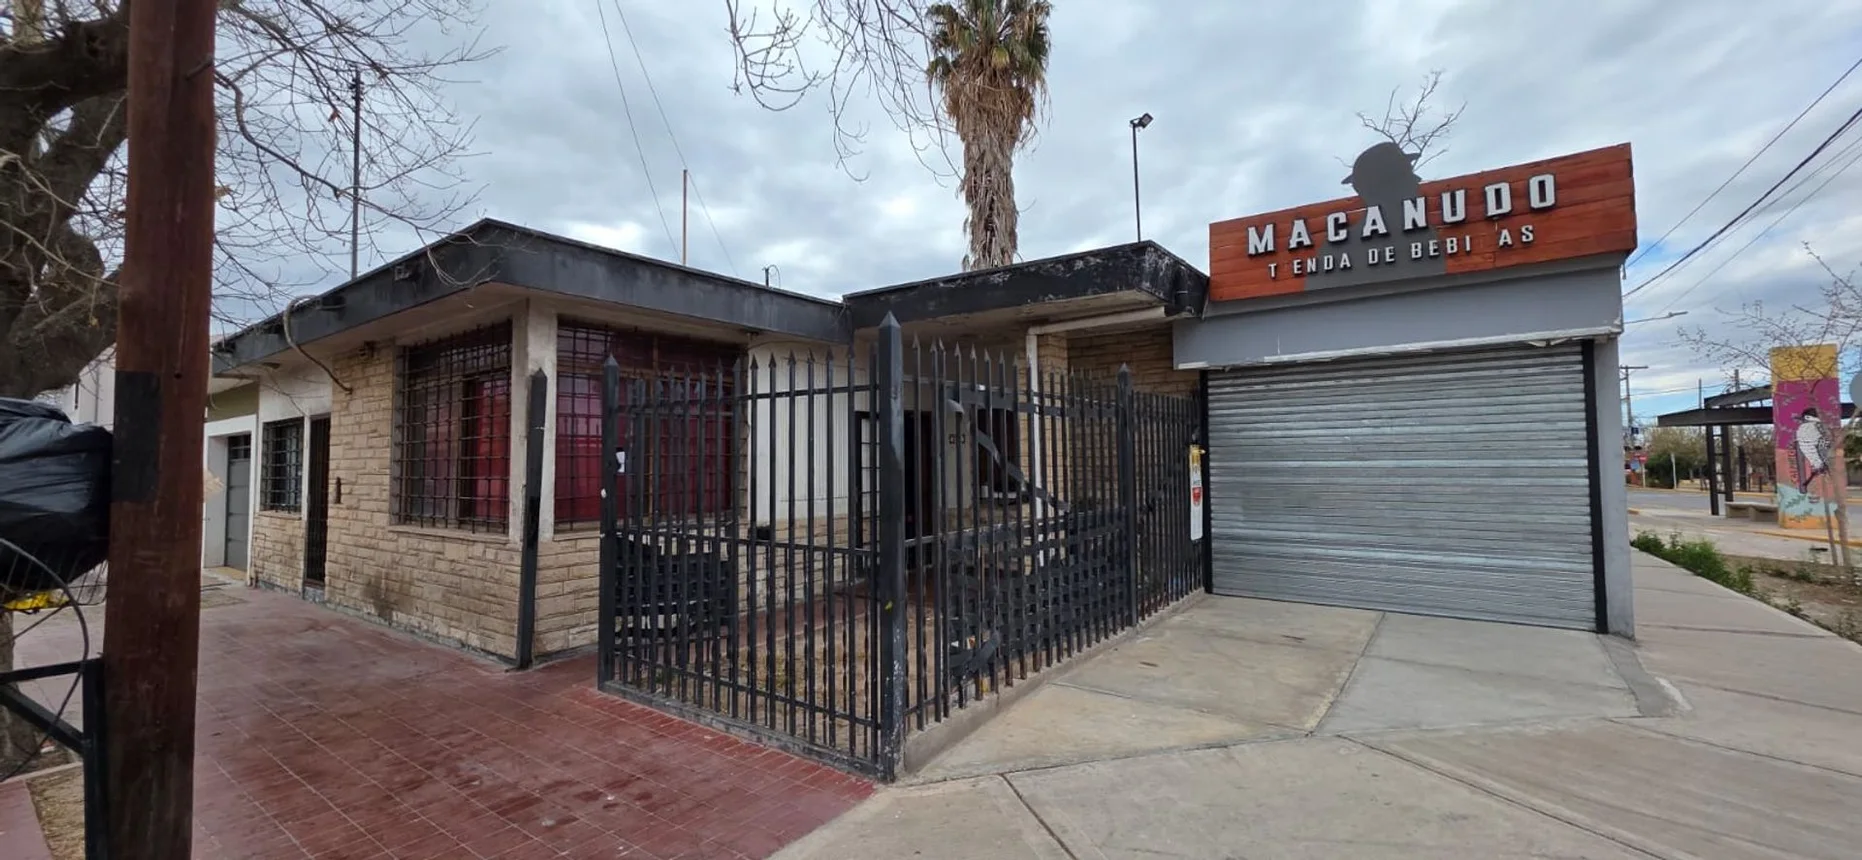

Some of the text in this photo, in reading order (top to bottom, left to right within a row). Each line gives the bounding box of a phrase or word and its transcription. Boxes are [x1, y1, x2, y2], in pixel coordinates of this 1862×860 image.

[1247, 173, 1557, 256] MACANUDO
[1268, 223, 1535, 279] TENDA DE BEBIAS
